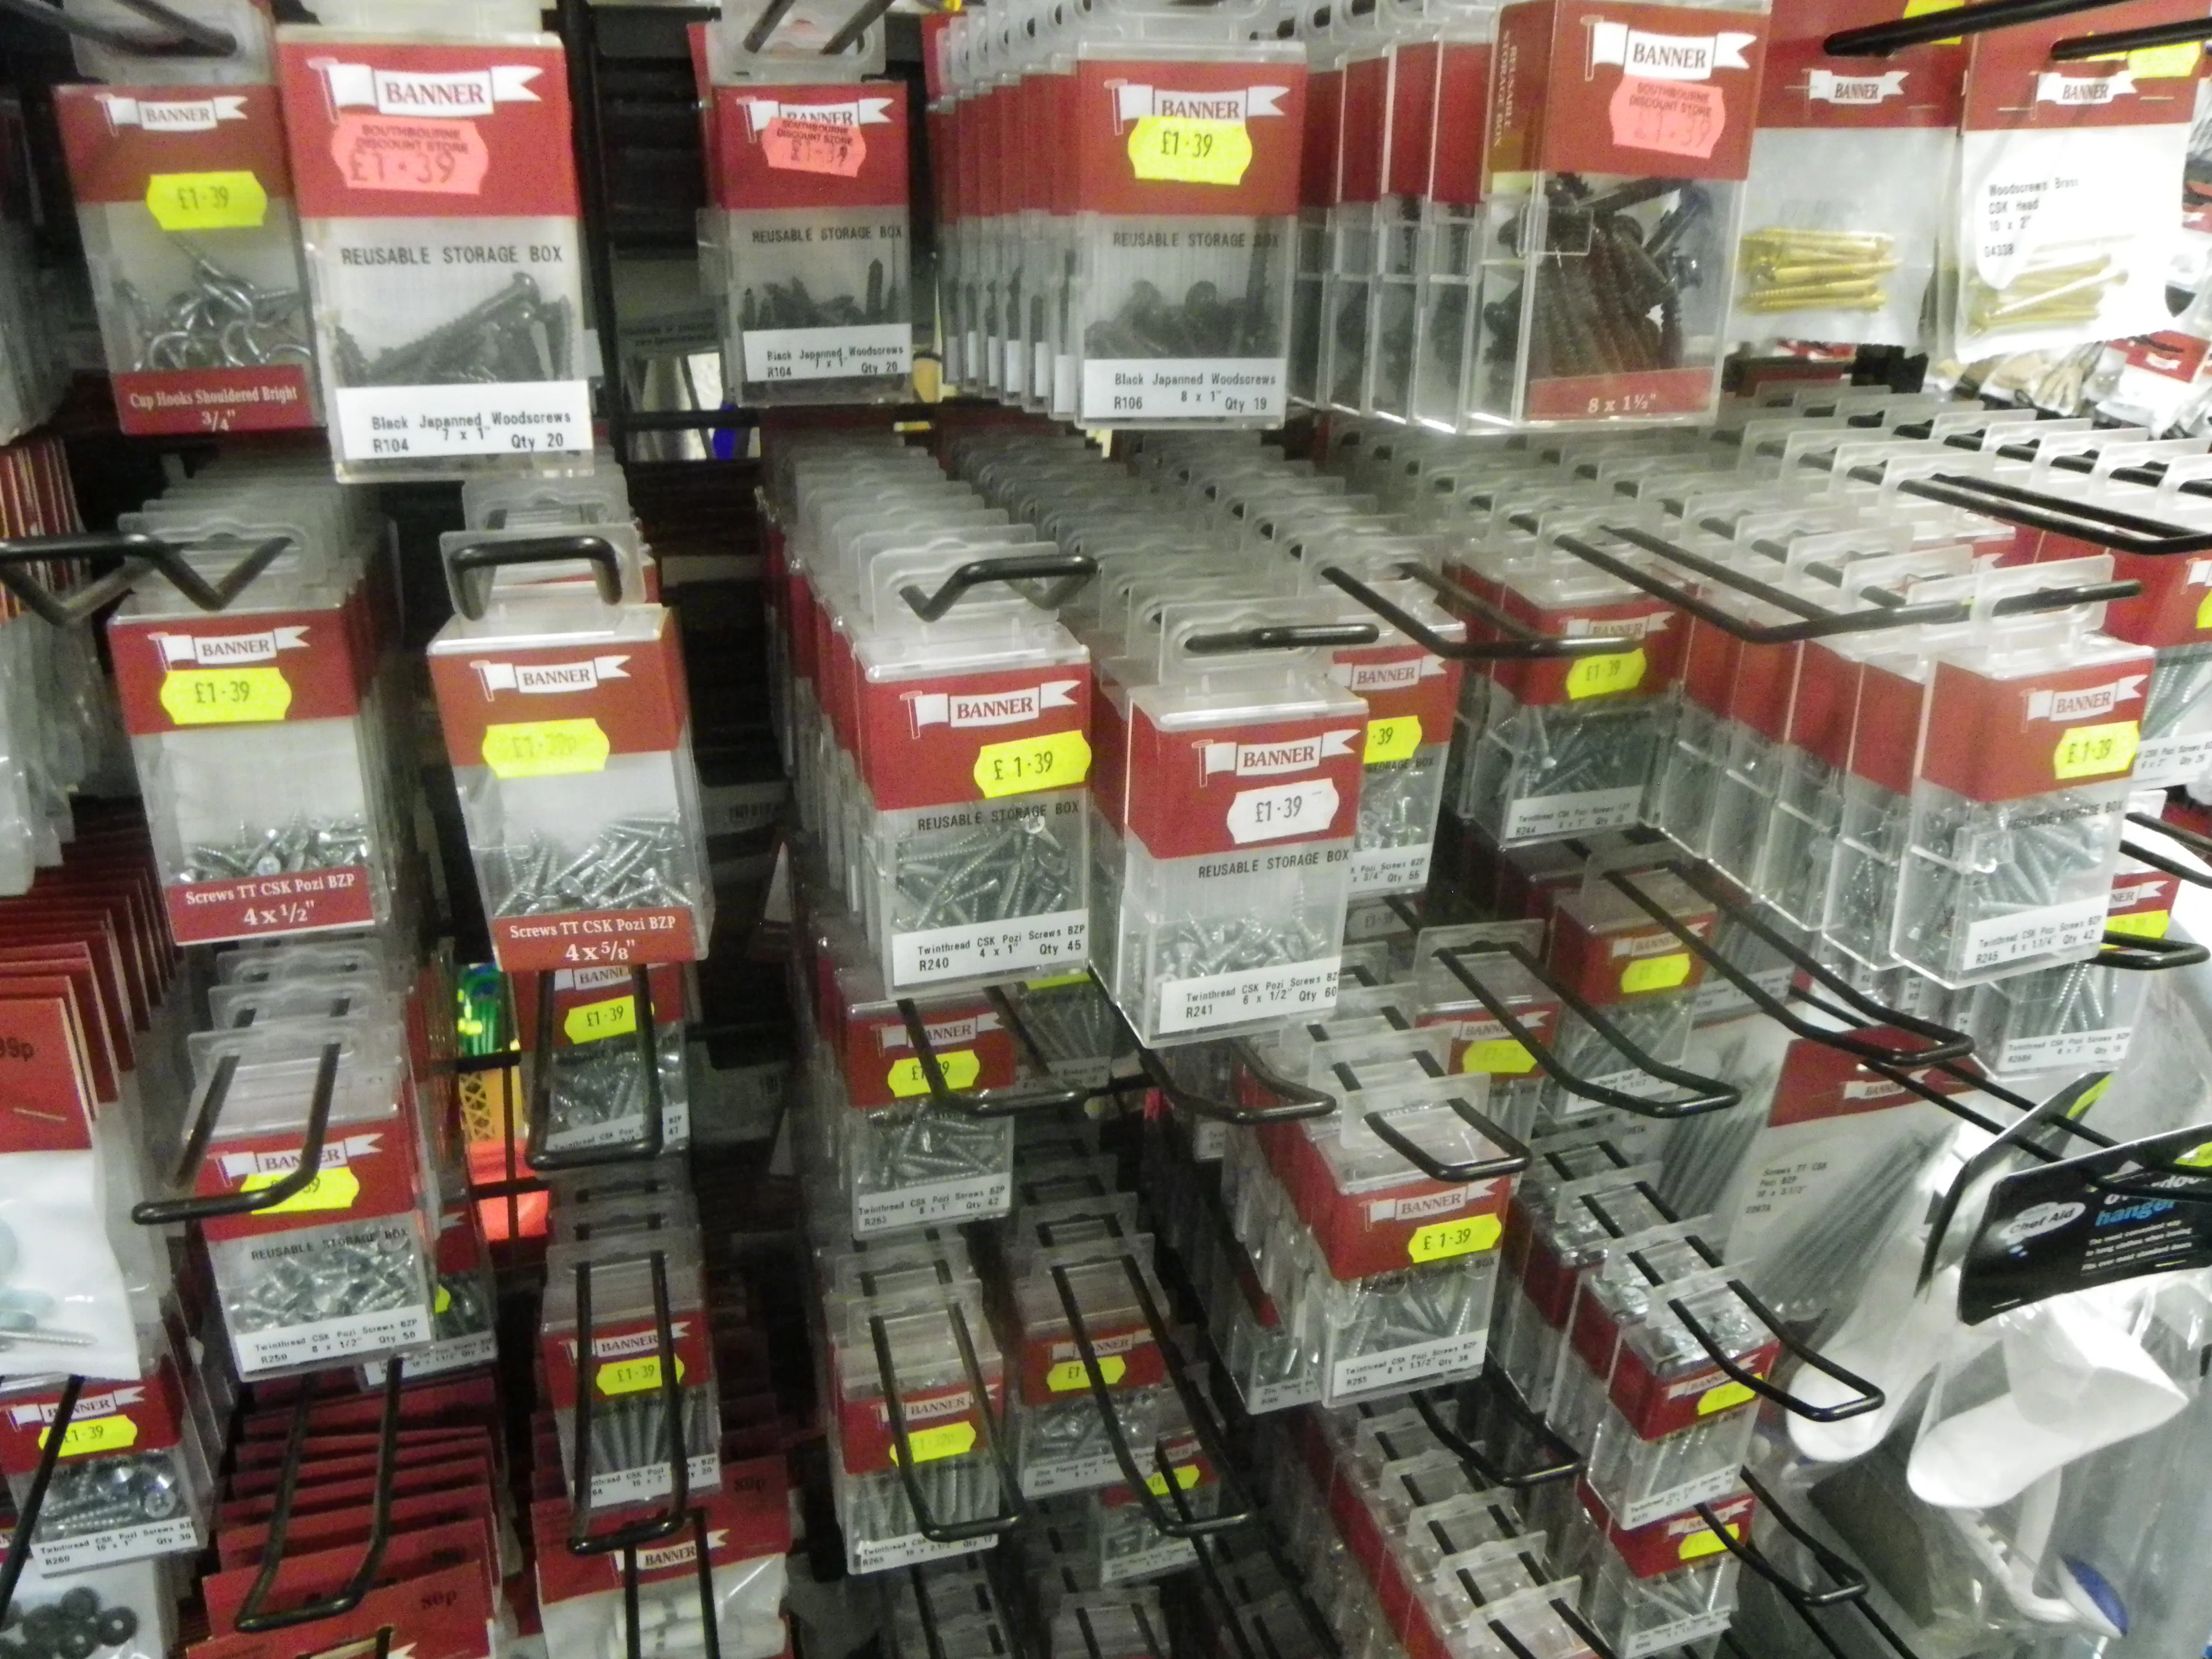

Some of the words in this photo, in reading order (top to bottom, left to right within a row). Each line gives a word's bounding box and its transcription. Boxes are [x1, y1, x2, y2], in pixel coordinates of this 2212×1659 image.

[1632, 43, 1707, 69] BANNER
[385, 82, 485, 105] BANNER
[1834, 82, 1880, 100] BANNER
[2062, 84, 2109, 101] BANNER
[147, 108, 210, 123] BANNER
[1161, 100, 1240, 119] BANNER
[752, 227, 812, 244] REUSABLE
[821, 226, 871, 241] STORAGE
[880, 225, 902, 239] BOX
[1113, 232, 1179, 248] REUSABLE
[1188, 232, 1245, 248] STORAGE
[342, 247, 431, 265] REUSABLE
[444, 246, 519, 264] STORAGE
[531, 246, 563, 263] BOX
[767, 350, 791, 361] Black
[800, 348, 842, 361] Japanned
[849, 345, 903, 357] Woodscrews
[768, 367, 791, 378] R104
[861, 362, 878, 375] Qty
[886, 361, 898, 373] 20
[1115, 373, 1144, 386] Black
[1152, 373, 1203, 387] Japanned
[1211, 372, 1276, 386] Woodscrews
[131, 392, 154, 410] Cup
[156, 389, 194, 407] Hooks
[196, 386, 260, 404] Shouldered
[262, 384, 298, 404] Bright
[1114, 396, 1142, 410] R106
[1225, 397, 1245, 413] Qty
[1254, 397, 1267, 410] 19
[1181, 390, 1187, 402] 8
[1195, 393, 1201, 402] x
[1587, 397, 1599, 414] 8
[1604, 399, 1615, 413] x
[372, 415, 409, 431] Black
[419, 413, 482, 431] Japanned
[492, 410, 571, 426] Woodscrews
[373, 438, 409, 453] R104
[511, 434, 536, 452] Qty
[547, 432, 565, 448] 20
[461, 430, 468, 441] x
[202, 639, 270, 657] BANNER
[523, 668, 590, 687] BANNER
[1357, 666, 1415, 685] BANNER
[957, 697, 1034, 719] BANNER
[2057, 691, 2111, 714] BANNER
[1243, 745, 1314, 768] BANNER
[918, 810, 983, 831] REUSABLE
[991, 804, 1047, 824] STORAGE
[1055, 800, 1079, 816] BOX
[1198, 859, 1259, 879] REUSABLE
[1267, 853, 1318, 870] STORAGE
[1327, 848, 1349, 863] BOX
[1387, 873, 1402, 883] Qty
[185, 889, 234, 906] Screws
[237, 884, 257, 900] TT
[260, 880, 292, 897] CSK
[295, 876, 324, 893] Pozi
[329, 873, 356, 889] BZP
[243, 908, 258, 926] 4
[261, 910, 278, 925] x
[510, 925, 558, 940] Screws
[559, 921, 580, 935] TT
[582, 919, 614, 935] CSK
[616, 917, 645, 932] Pozi
[650, 915, 676, 931] BZP
[918, 940, 971, 956] Twinthread
[977, 936, 995, 948] CSK
[1003, 933, 1022, 945] Pozi
[1029, 929, 1062, 940] Screws
[1068, 924, 1086, 936] BZP
[565, 943, 580, 961] 4
[583, 947, 600, 961] x
[919, 957, 950, 972] R240
[1040, 942, 1059, 956] Qty
[1068, 940, 1082, 951] 45
[979, 948, 986, 958] 4
[1186, 987, 1236, 1003] Twinthread
[1242, 983, 1259, 995] CSK
[1266, 979, 1284, 991] Pozi
[1290, 976, 1321, 988] Screws
[1186, 1004, 1213, 1019] R241
[1299, 990, 1317, 1002] Qty
[1243, 995, 1249, 1005] 6
[1402, 1193, 1461, 1214] BANNER
[252, 1243, 314, 1261] REUSABLE
[255, 1337, 306, 1353] Twinthread
[312, 1333, 330, 1343] CSK
[337, 1328, 356, 1339] Pozi
[362, 1323, 395, 1335] Screws
[400, 1318, 418, 1329] BZP
[379, 1333, 396, 1345] Qty
[602, 1334, 659, 1353] BANNER
[1391, 1357, 1406, 1365] CSK
[911, 1396, 966, 1416] BANNER
[645, 1545, 697, 1567] BANNER
